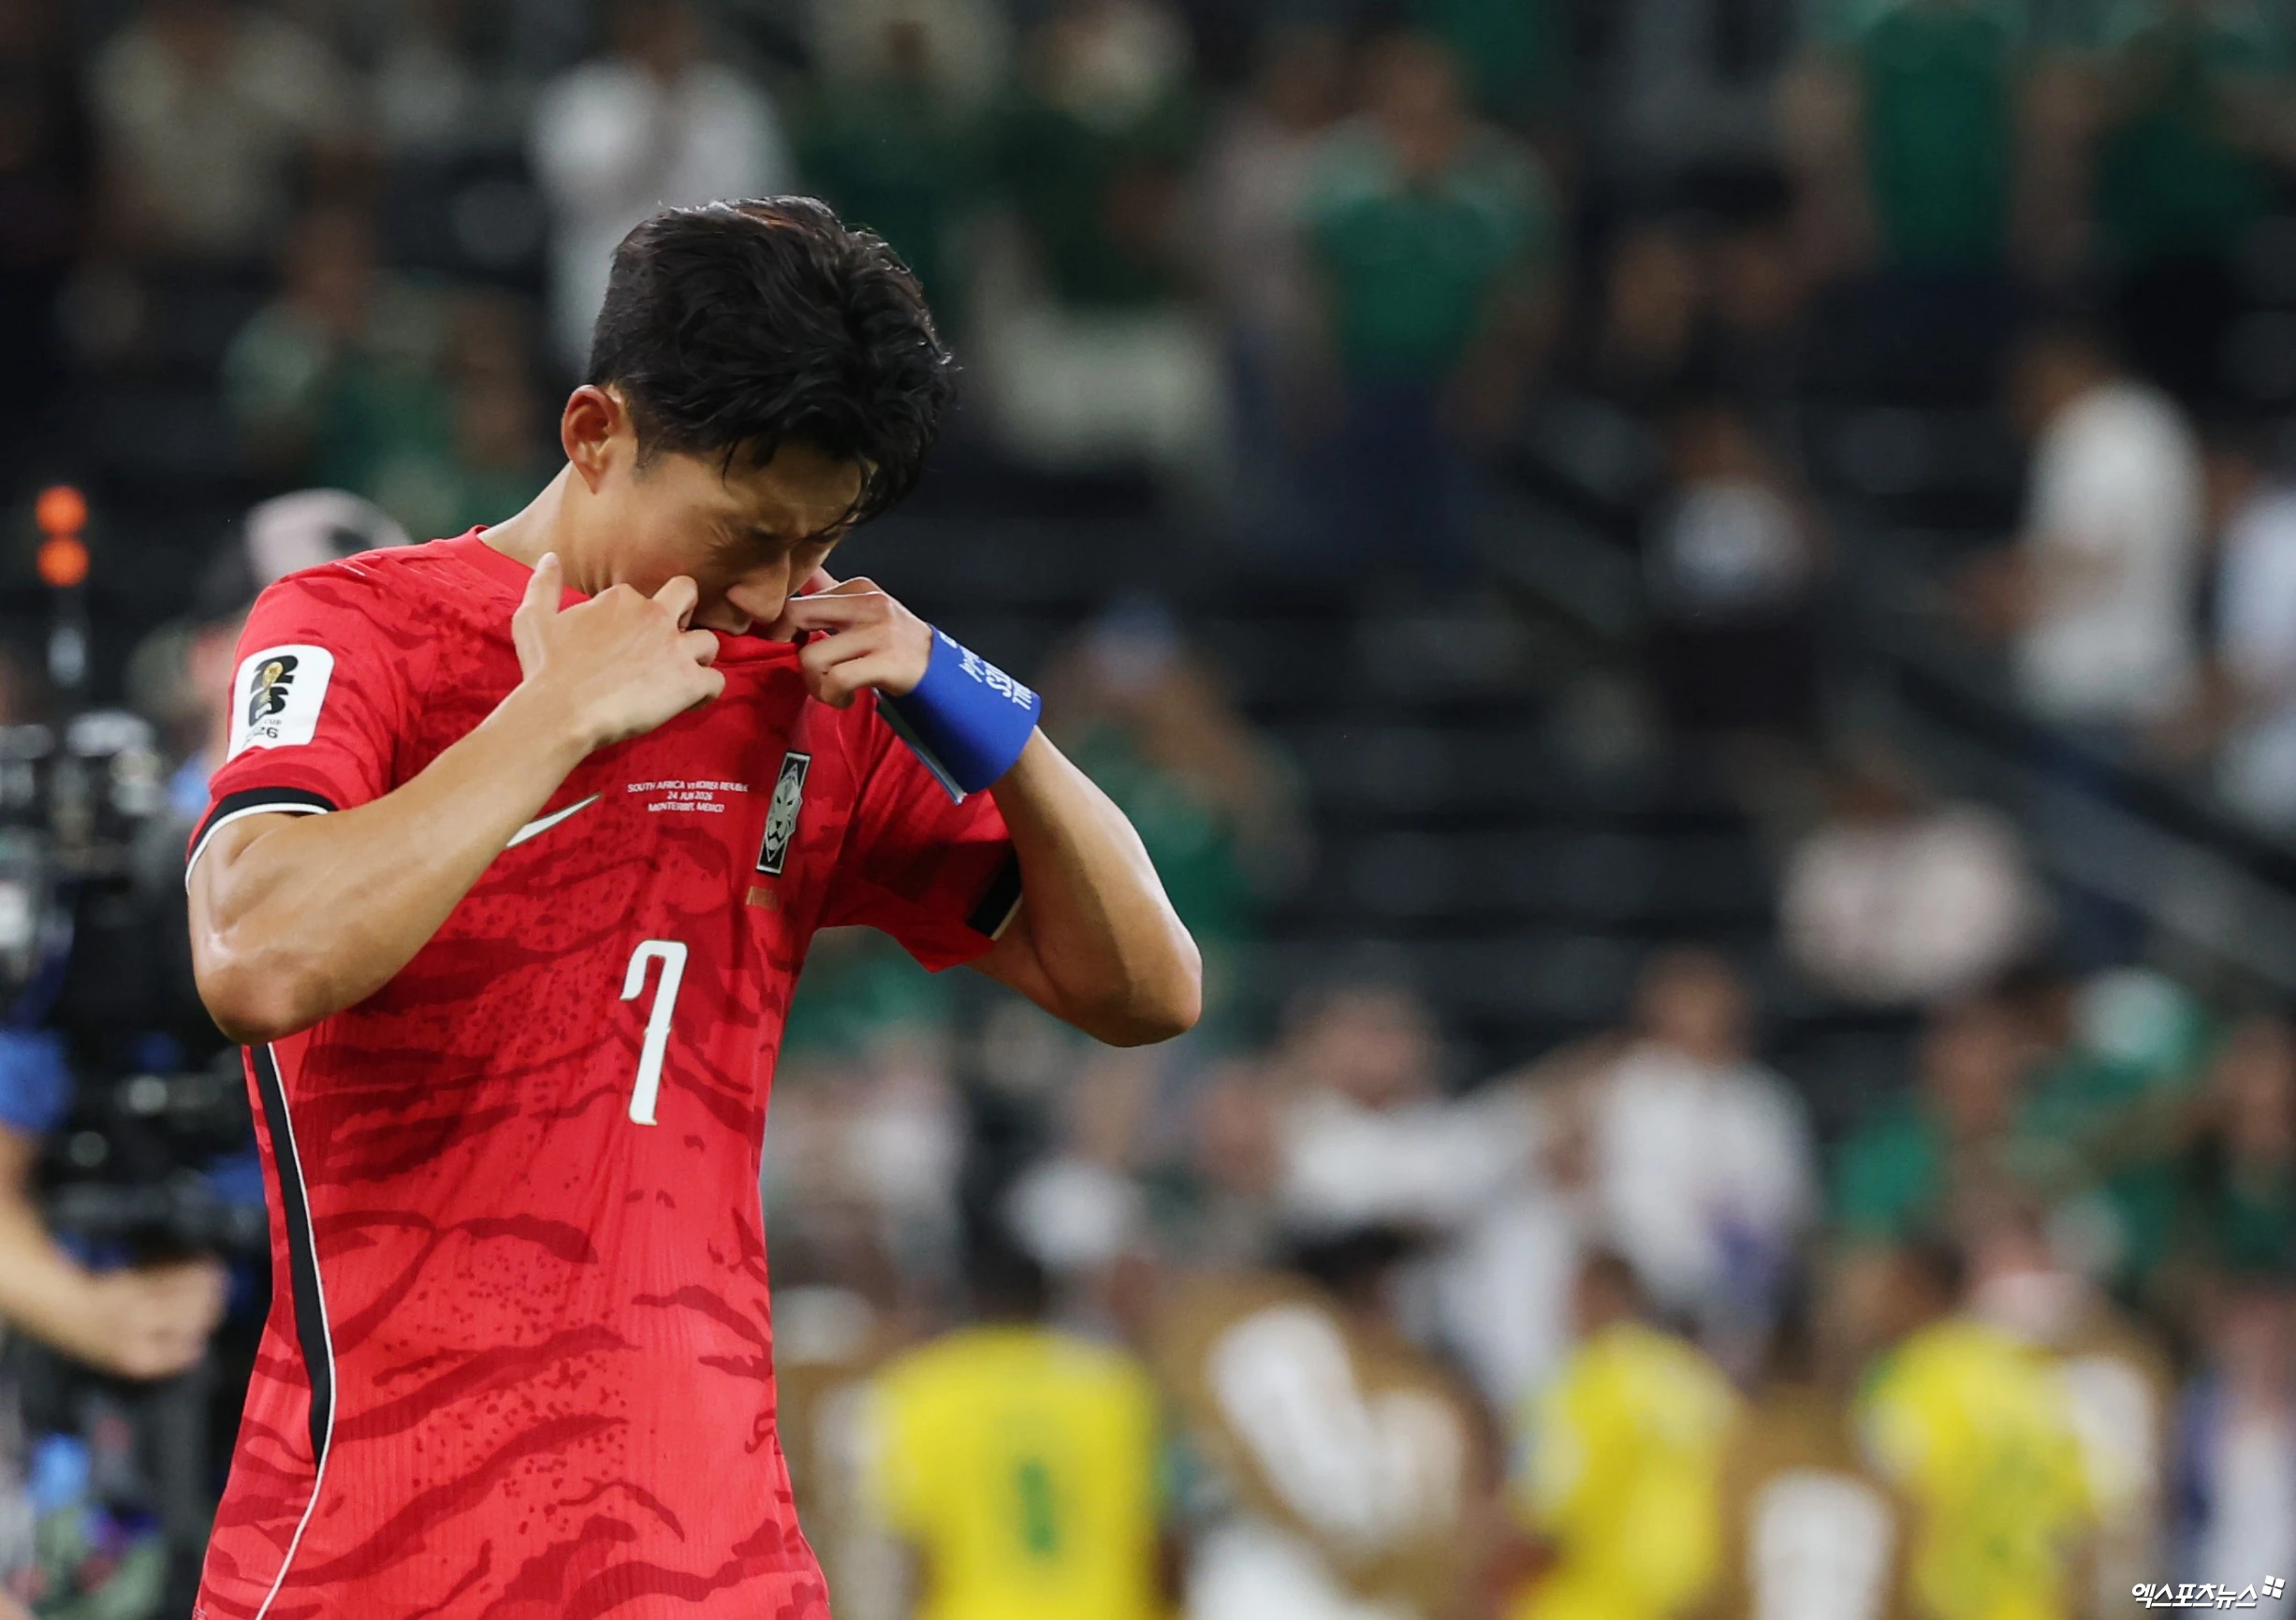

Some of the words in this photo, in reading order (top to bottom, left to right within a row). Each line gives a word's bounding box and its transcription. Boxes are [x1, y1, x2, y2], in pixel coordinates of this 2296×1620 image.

[627, 781, 655, 793] SOUTH
[656, 780, 685, 790] AFRICA
[666, 790, 679, 800] 24
[695, 790, 713, 800] 2026
[620, 939, 688, 1126] 7
